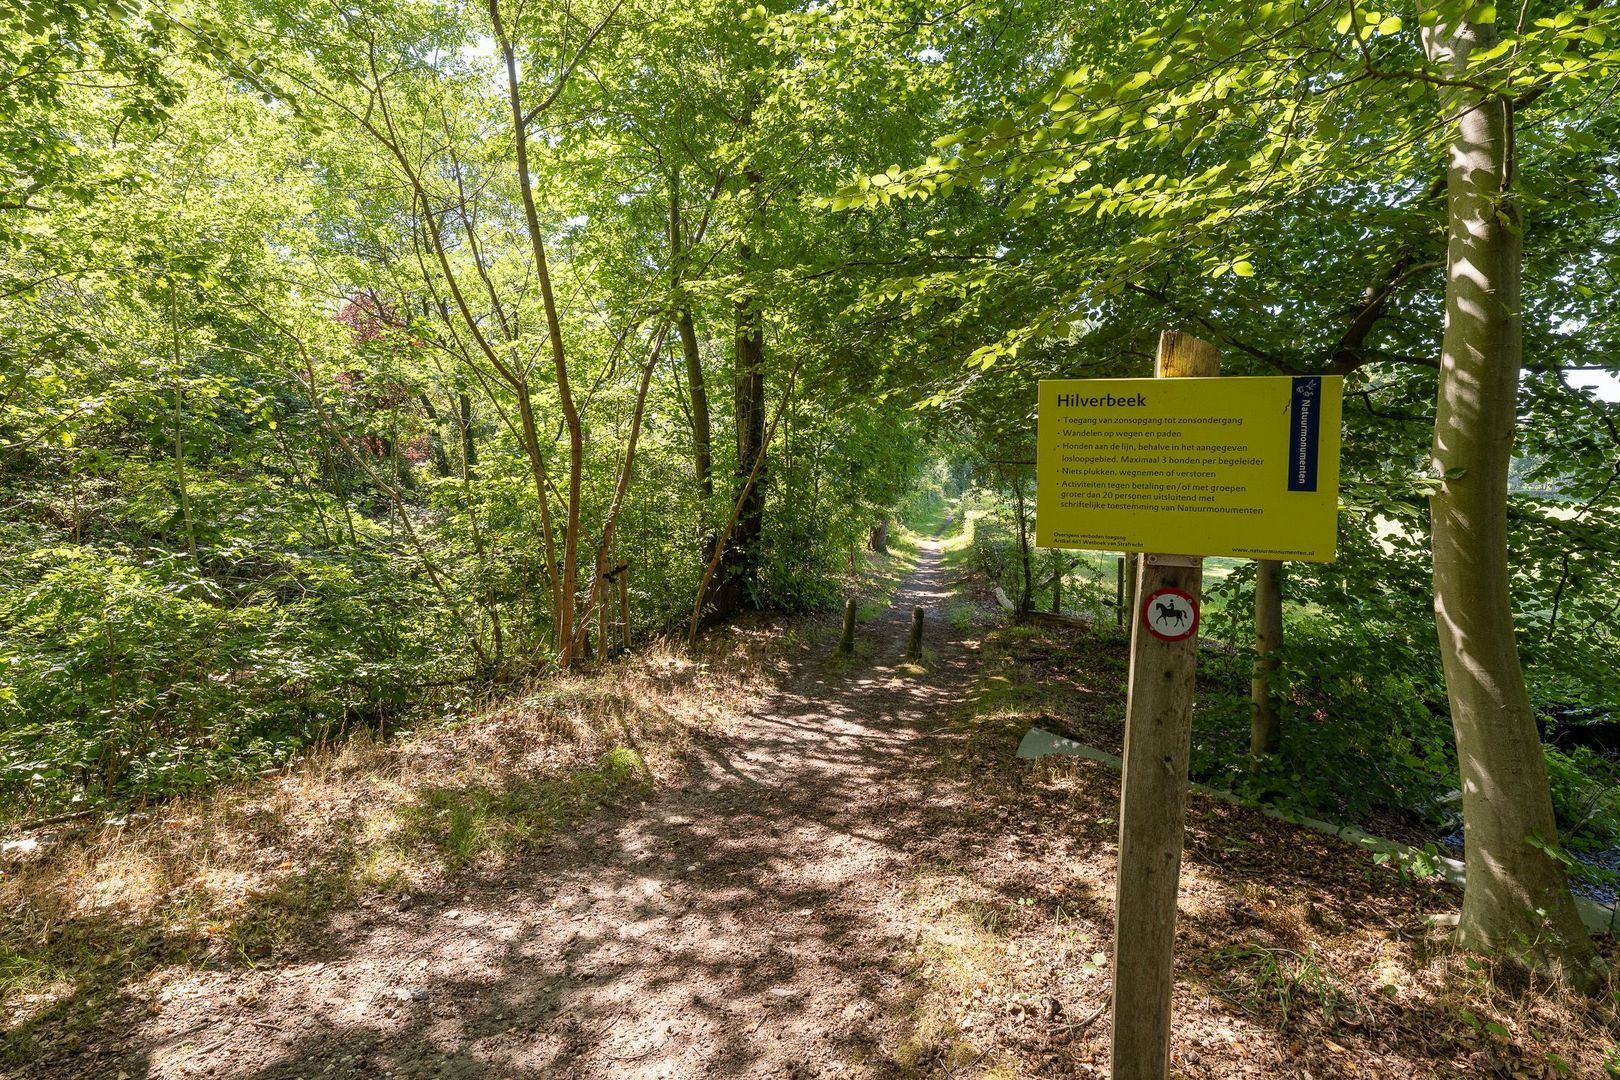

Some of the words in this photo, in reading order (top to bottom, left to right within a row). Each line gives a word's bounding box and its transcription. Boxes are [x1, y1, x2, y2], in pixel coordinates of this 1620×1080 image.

[1057, 393, 1147, 407] Hilverbeek
[1064, 416, 1097, 425] Toegang
[1178, 416, 1243, 425] zonsondergang
[1157, 430, 1182, 438] paden
[1298, 400, 1310, 484] Natuurmonumenten
[1122, 443, 1136, 451] lijn,
[1062, 456, 1118, 464] losloopgebied.
[1121, 456, 1160, 464] Maximaal
[1218, 457, 1264, 466] begeleider
[1083, 468, 1117, 476] plukken,
[1132, 482, 1164, 491] betaling
[1166, 483, 1191, 491] en/of
[1060, 501, 1106, 510] schriftelijke
[1107, 504, 1159, 512] toestemming
[1177, 505, 1264, 514] Natuurmonumenten
[1232, 547, 1314, 556] www.natuurmonumenten.nl
